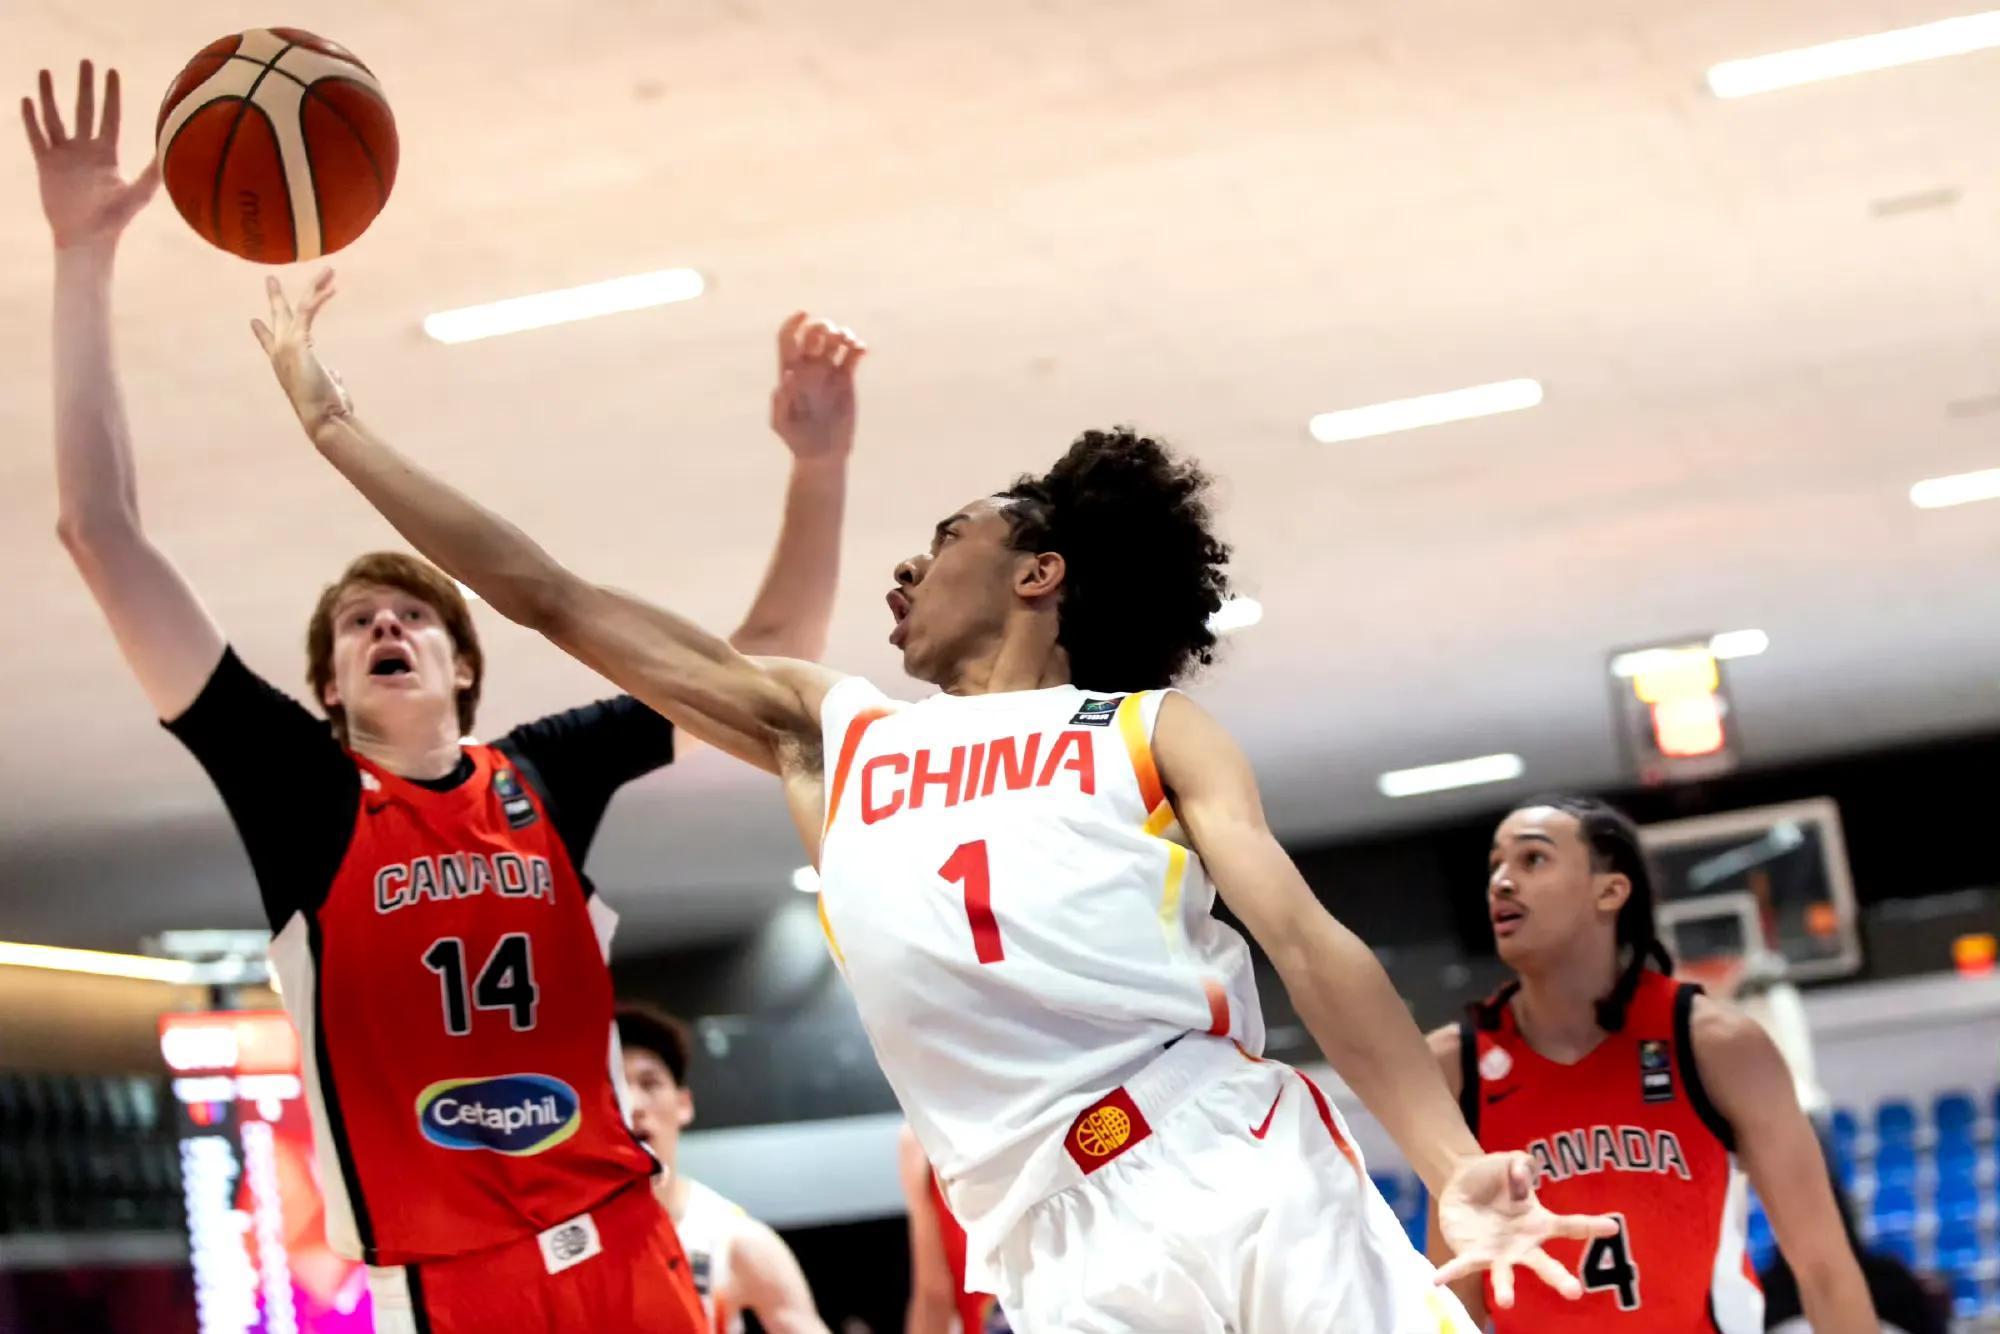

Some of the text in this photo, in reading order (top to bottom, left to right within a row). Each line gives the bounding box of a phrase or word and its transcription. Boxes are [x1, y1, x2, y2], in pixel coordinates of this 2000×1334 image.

[861, 731, 1095, 825] CHINA
[374, 851, 556, 915] CANADA
[937, 839, 1005, 964] 1
[421, 932, 540, 1036] 14
[433, 1095, 561, 1135] Cetaphil
[1526, 1125, 1692, 1189] ANADA
[1578, 1212, 1641, 1311] 4
